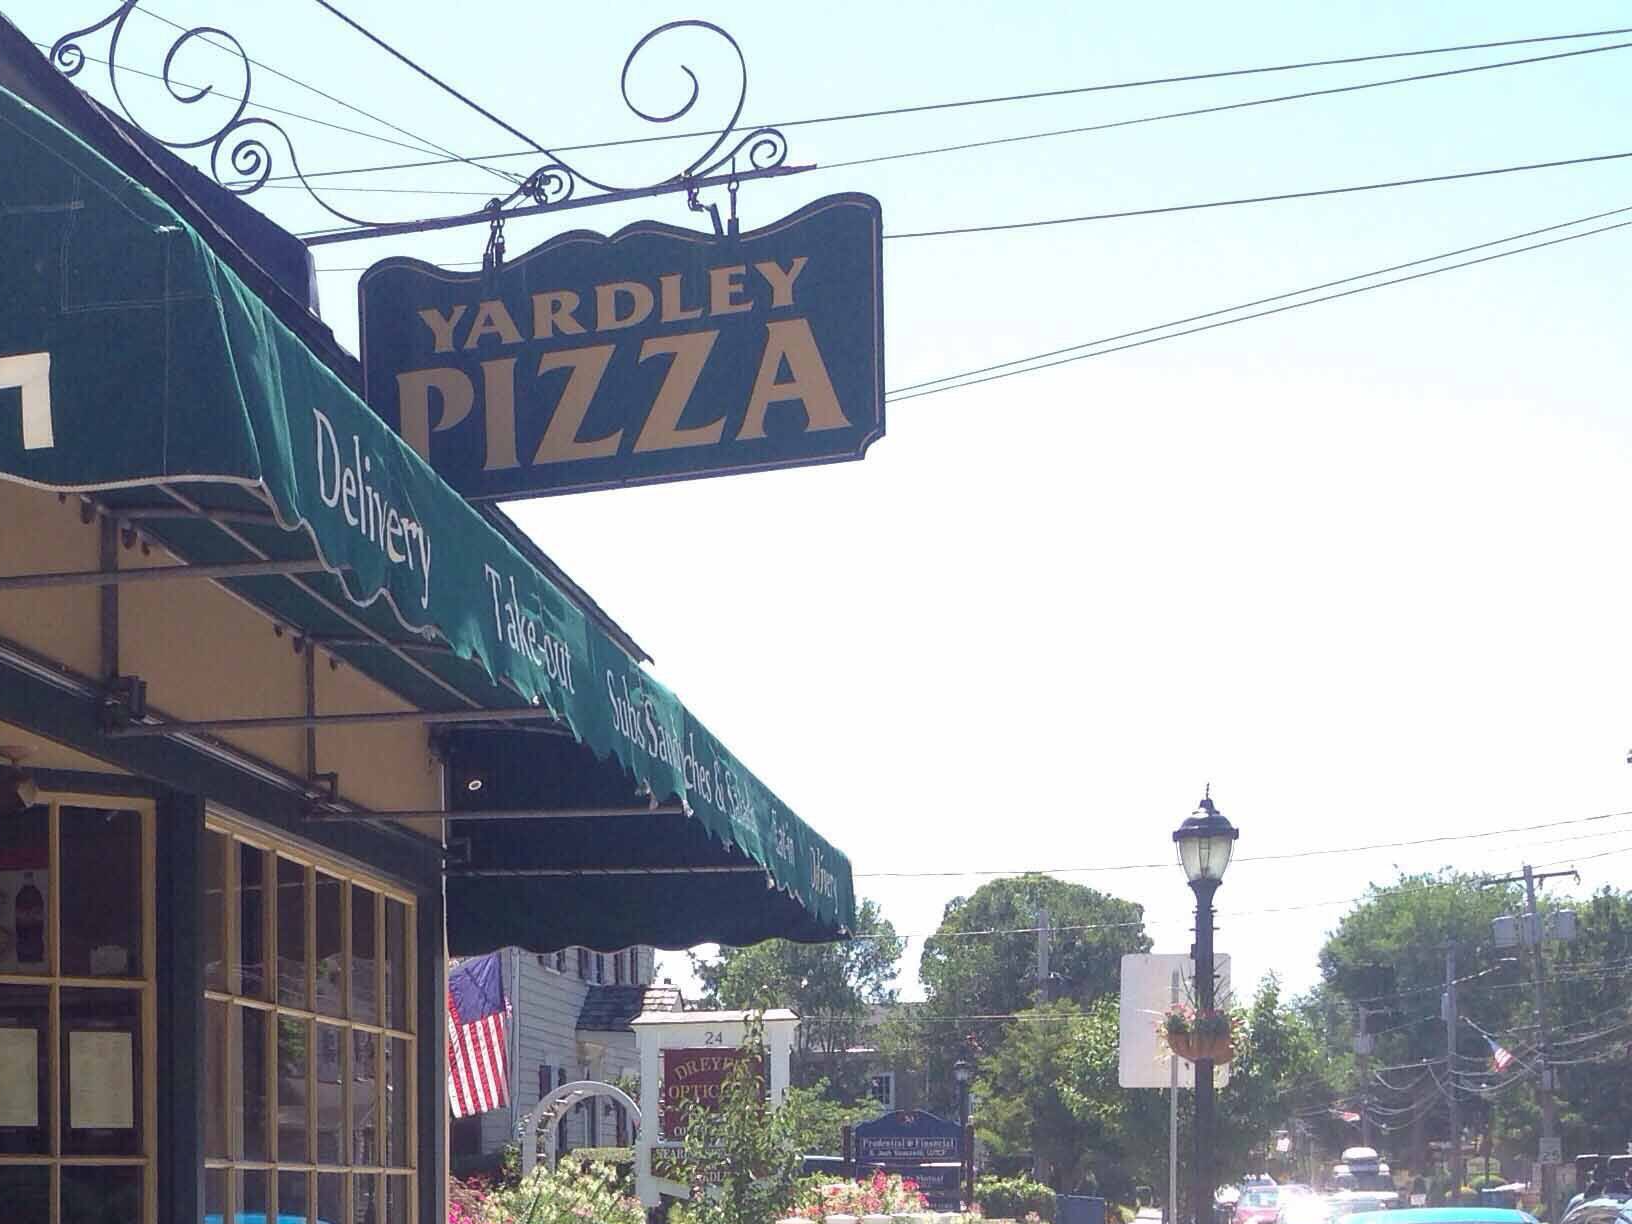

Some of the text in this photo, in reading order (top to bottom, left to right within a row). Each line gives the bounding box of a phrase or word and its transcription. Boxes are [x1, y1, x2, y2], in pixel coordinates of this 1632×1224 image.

[416, 256, 809, 353] YARDLEY
[394, 317, 854, 473] PIZZA
[312, 407, 432, 608] Delivery
[484, 563, 576, 695] Take-out
[606, 669, 645, 751] Subs
[644, 700, 712, 804] Sanches
[704, 1031, 723, 1045] 24
